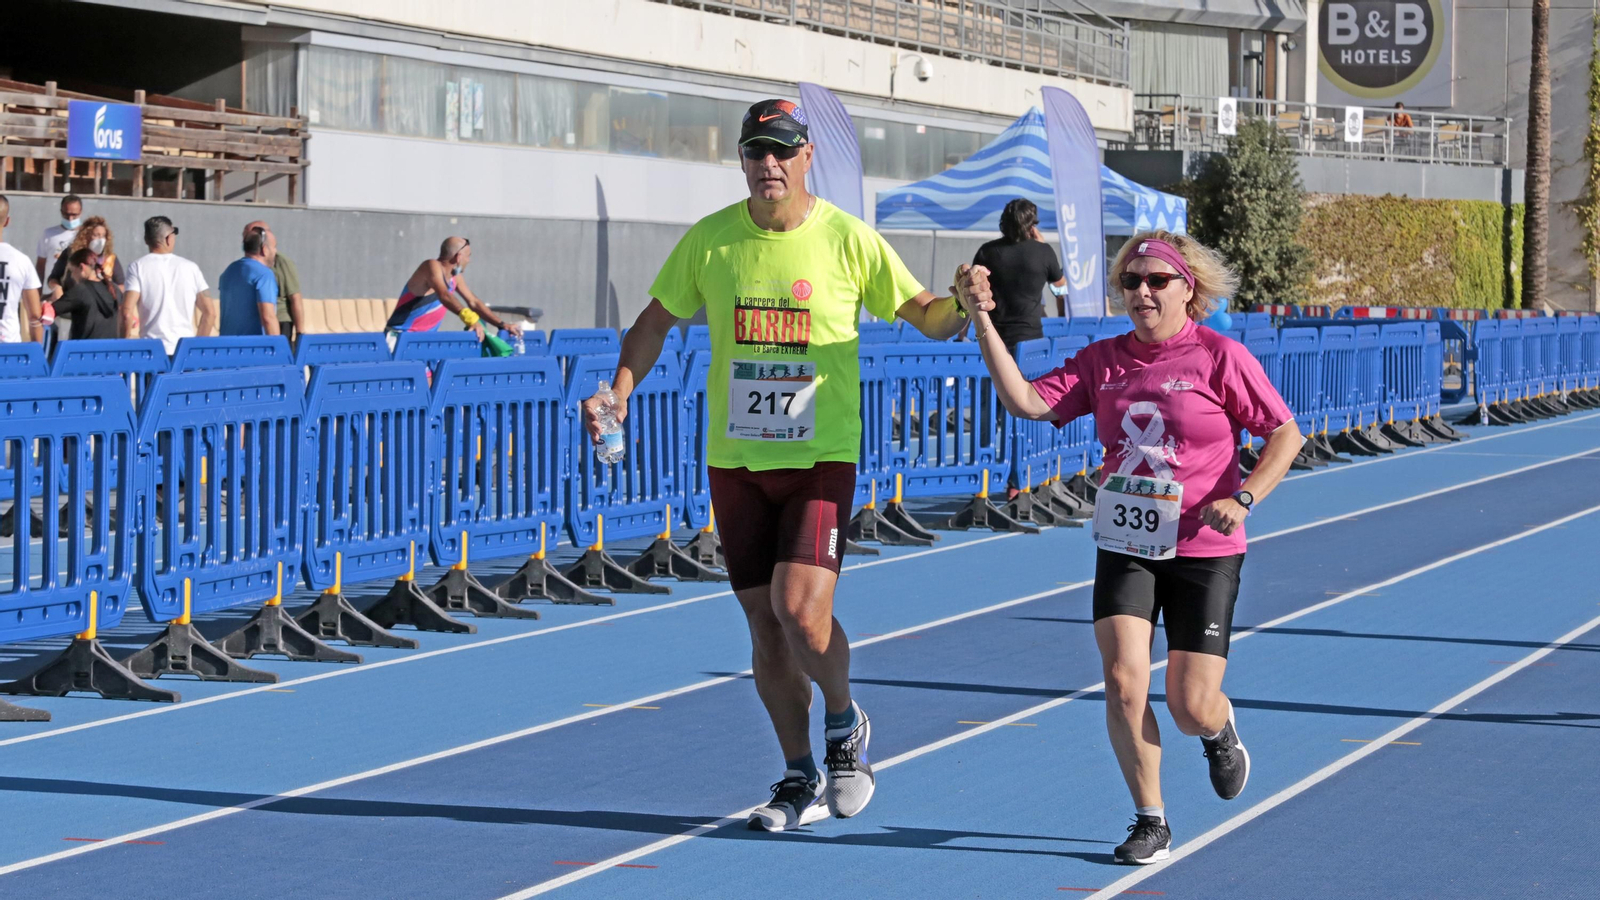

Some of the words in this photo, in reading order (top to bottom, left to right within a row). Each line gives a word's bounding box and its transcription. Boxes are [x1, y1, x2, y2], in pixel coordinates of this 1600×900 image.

[1328, 3, 1427, 45] B&B
[1341, 49, 1411, 64] HOTELS
[744, 297, 776, 307] carrera
[778, 297, 789, 308] del
[734, 308, 811, 344] BARRO
[753, 345, 760, 353] La
[763, 345, 779, 354] Barca
[781, 346, 808, 355] EXTREME
[748, 391, 796, 415] 217
[1113, 503, 1159, 533] 339
